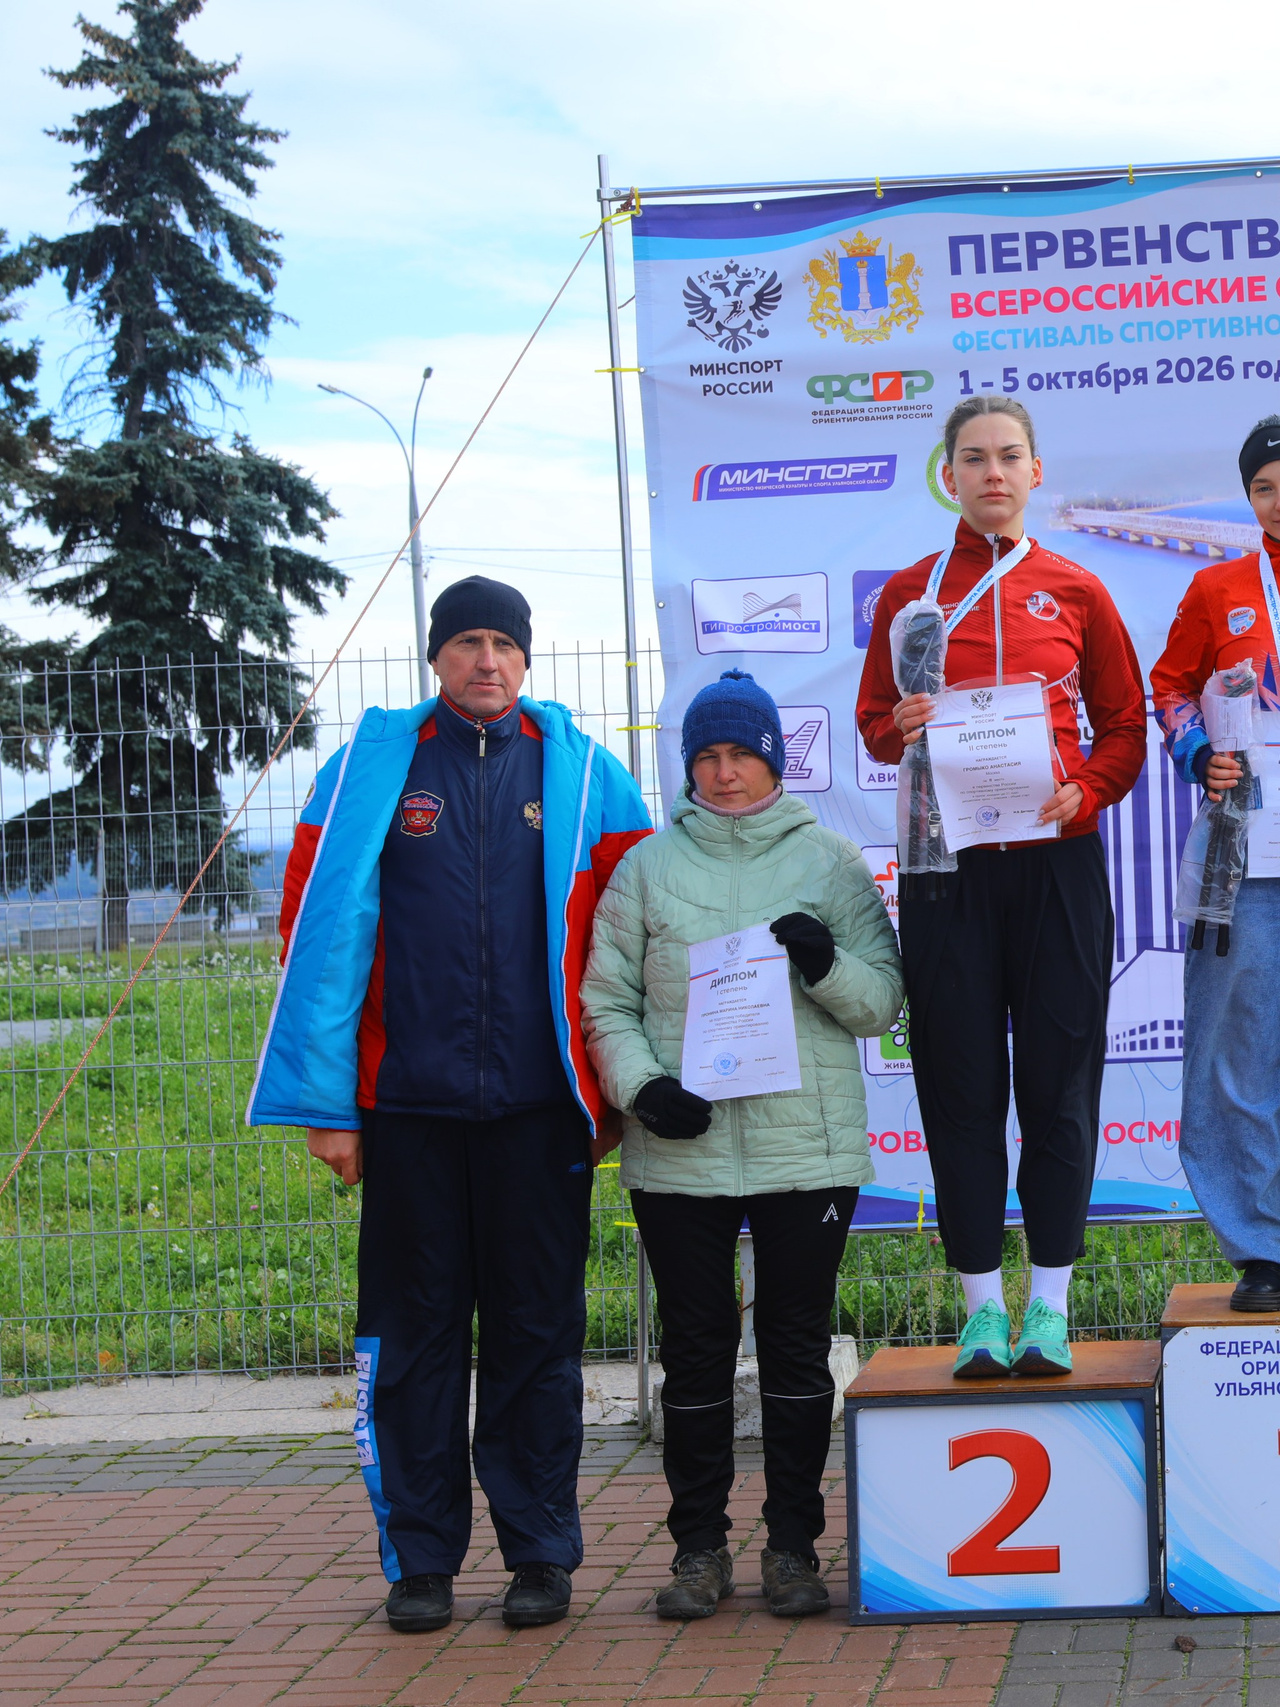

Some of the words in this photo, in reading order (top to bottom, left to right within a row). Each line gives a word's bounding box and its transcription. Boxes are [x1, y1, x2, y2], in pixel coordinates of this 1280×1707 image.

[950, 274, 1267, 318] ВСЕРОССИЙСКИЕ
[952, 324, 1113, 353] ФЕСТИВАЛЬ
[690, 359, 783, 377] МИНСПОРТ
[959, 370, 973, 394] 1
[1002, 367, 1019, 393] 5
[1027, 362, 1148, 394] октября
[1156, 355, 1235, 385] 2026
[703, 380, 773, 396] РОССИИ
[812, 407, 865, 417] ФЕДЕРАЦИЯ
[868, 404, 933, 413] СПОРТИВНОГО
[812, 415, 893, 424] ОРИЕНТИРОВАНИЯ
[896, 412, 933, 421] РОССИИ
[720, 461, 888, 486] МИНСПОРТ
[1268, 584, 1279, 620] МИНИСТЕРСТВО
[958, 727, 1016, 744] ДИПЛОМ
[976, 742, 1007, 750] степень
[710, 970, 757, 990] ДИПЛОМ
[720, 986, 748, 995] степень
[948, 1428, 1060, 1577] 2
